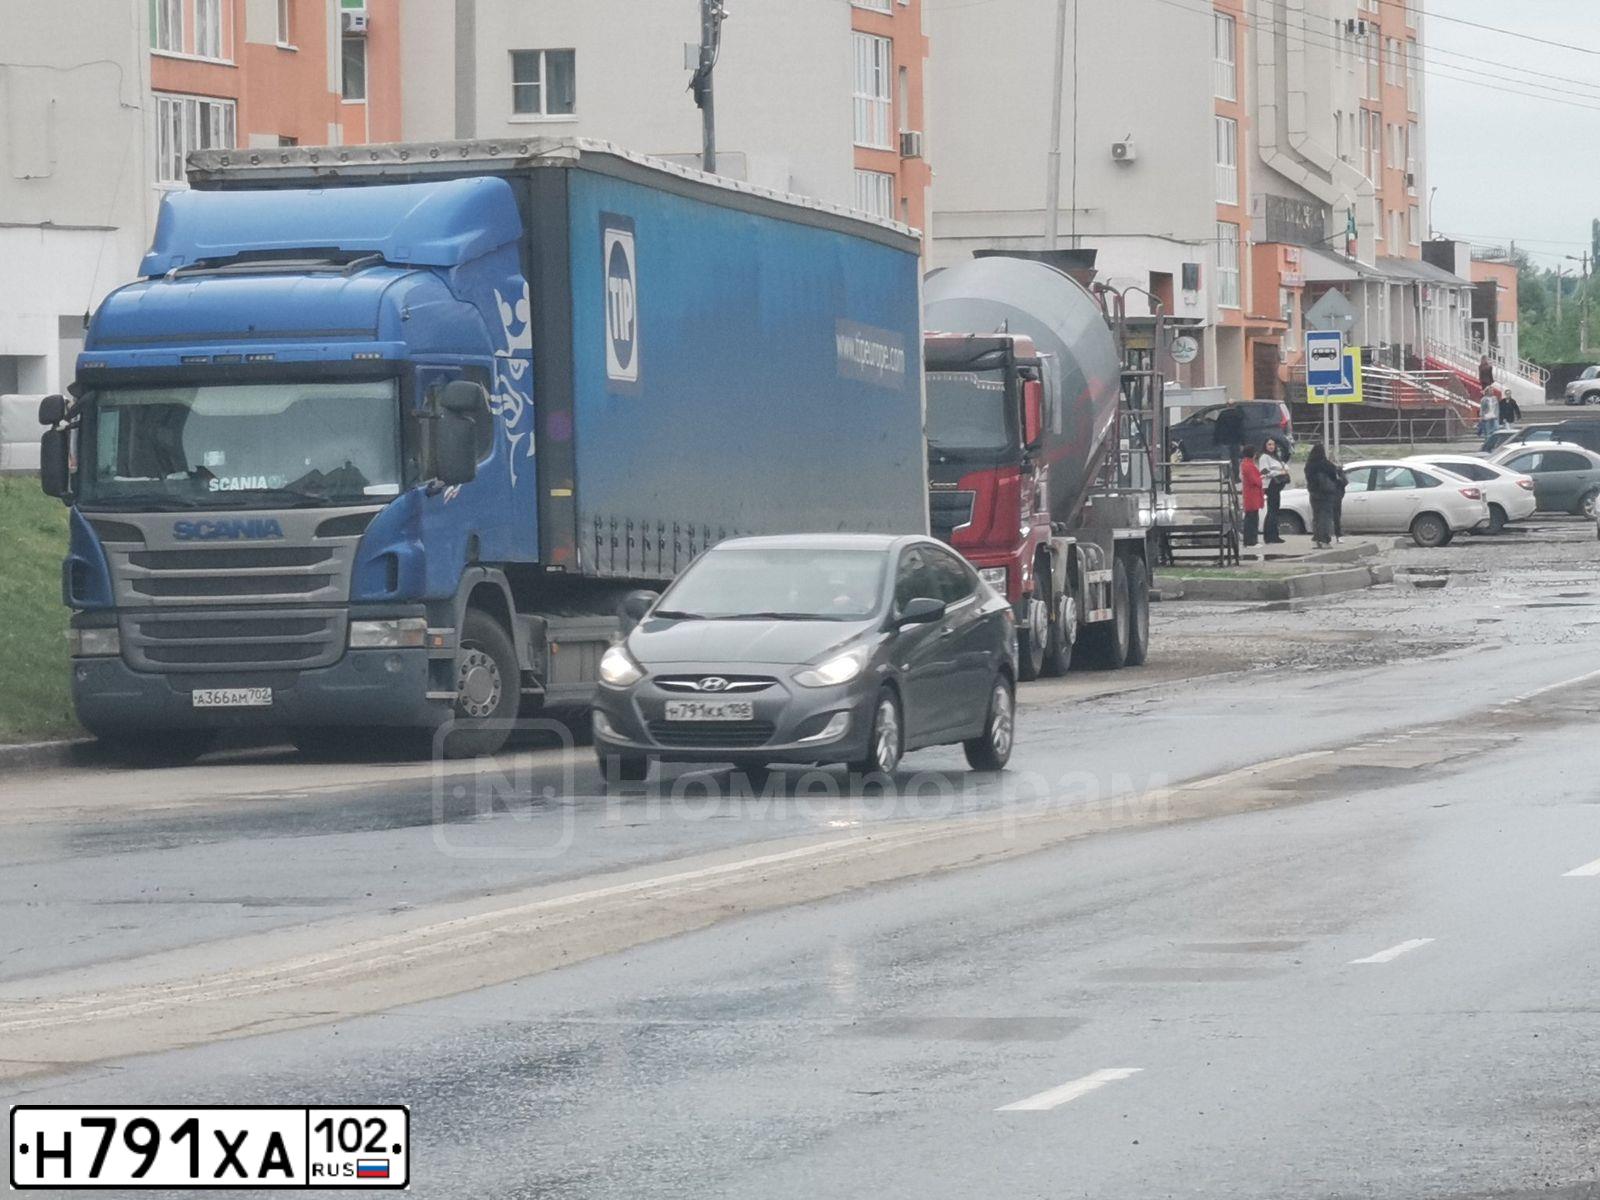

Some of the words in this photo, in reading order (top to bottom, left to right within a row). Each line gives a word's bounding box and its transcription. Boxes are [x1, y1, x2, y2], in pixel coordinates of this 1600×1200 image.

[609, 276, 633, 341] TIP
[209, 476, 268, 492] SCANIA
[173, 518, 284, 540] SCANIA
